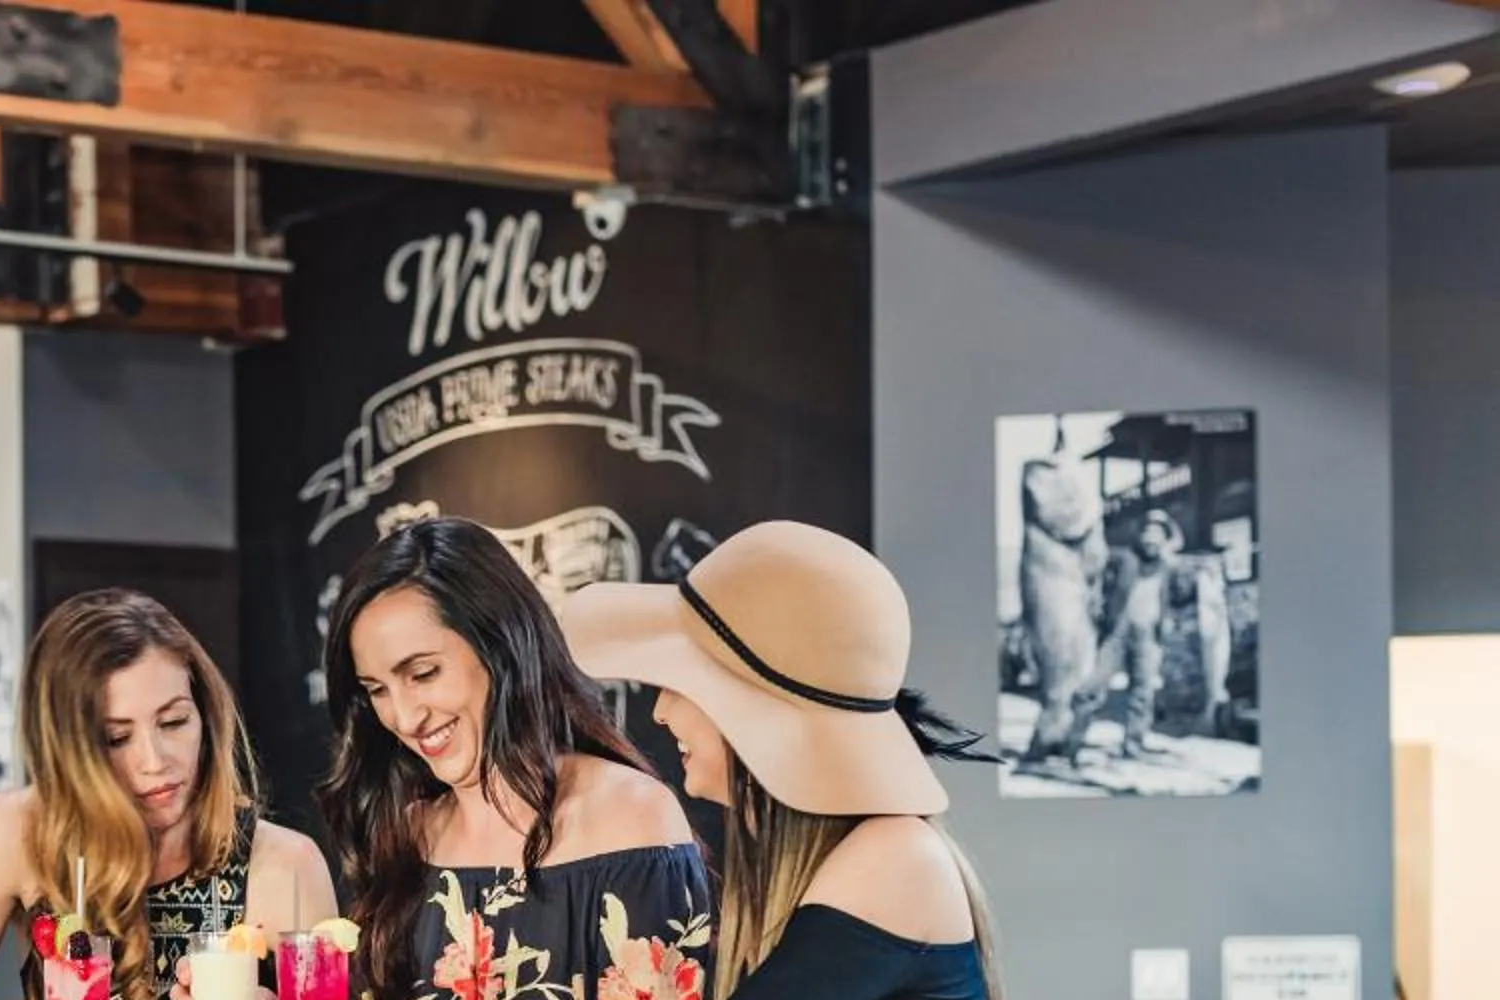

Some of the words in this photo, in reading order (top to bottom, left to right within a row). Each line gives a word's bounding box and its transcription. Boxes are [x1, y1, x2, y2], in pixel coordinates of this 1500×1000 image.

[384, 208, 606, 356] Willow
[376, 385, 441, 453] USDA
[440, 360, 520, 422] PRIME
[525, 353, 620, 409] STEAKS
